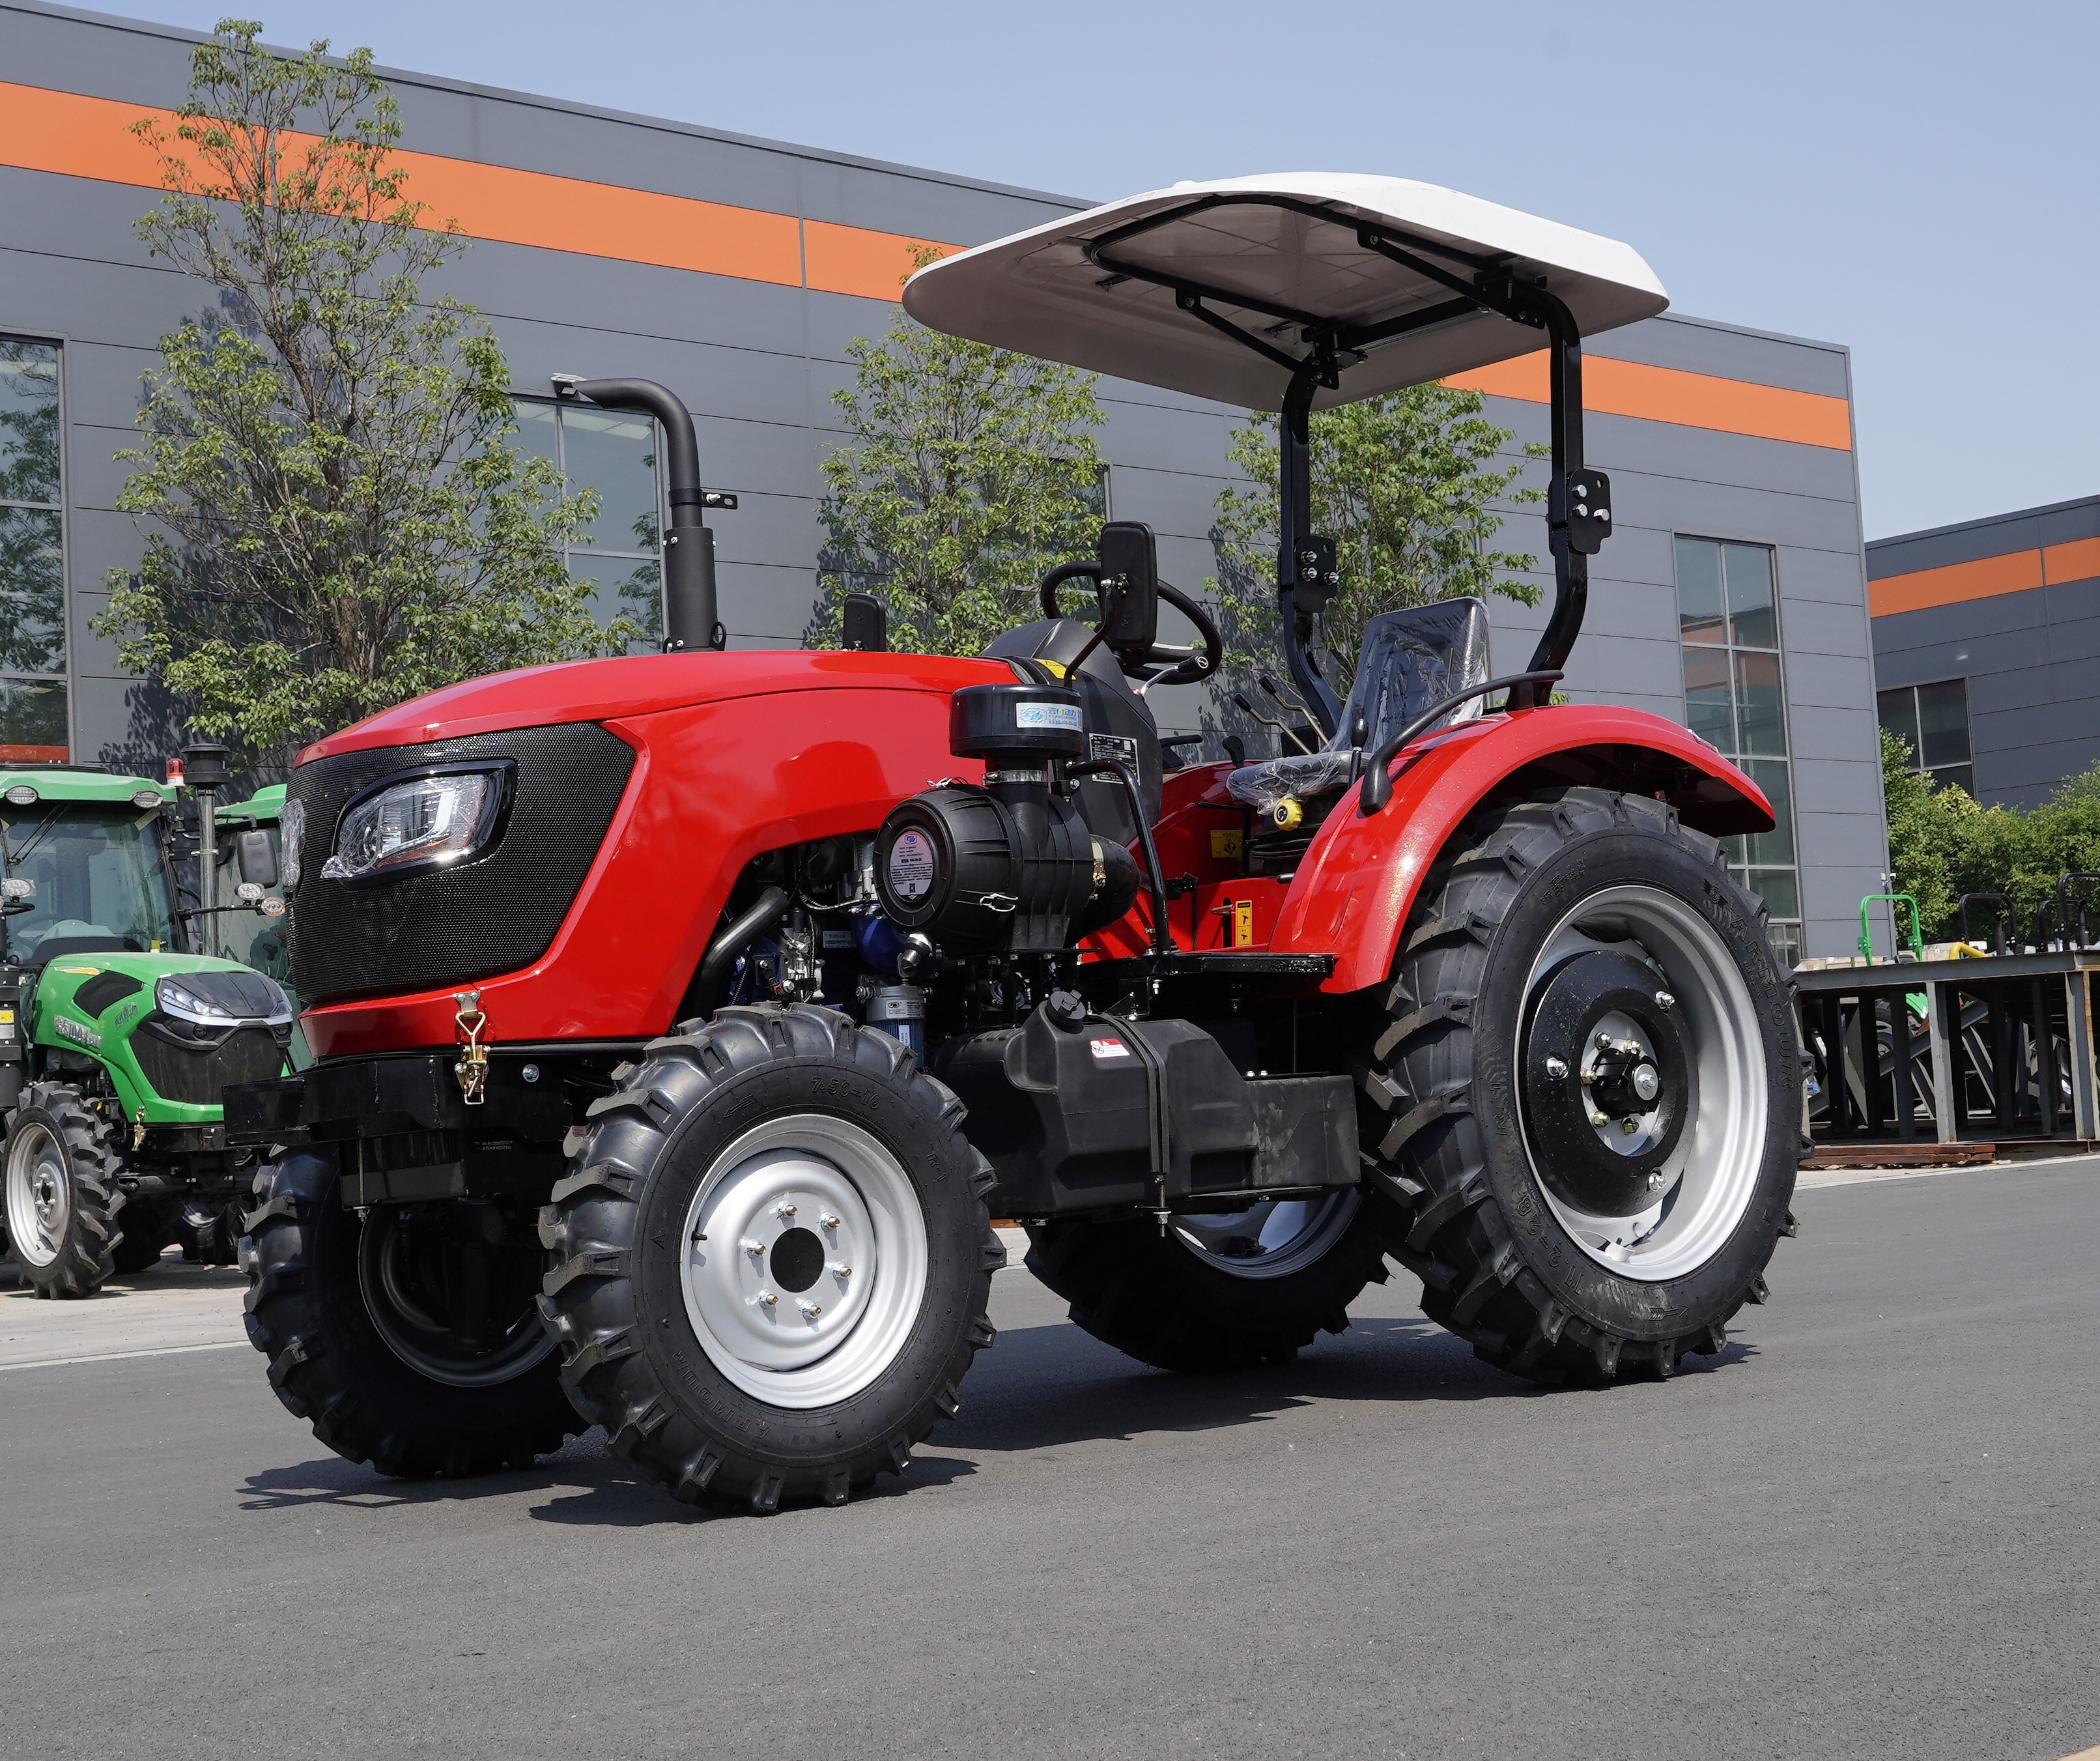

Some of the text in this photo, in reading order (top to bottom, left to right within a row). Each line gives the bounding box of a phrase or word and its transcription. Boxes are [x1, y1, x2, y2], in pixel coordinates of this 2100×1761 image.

[1731, 919, 1794, 1092] ARMOUR
[811, 1076, 881, 1110] 7.50-16
[926, 1152, 947, 1182] R-1
[1517, 1196, 1585, 1296] 11.2-28
[672, 1351, 771, 1439] ARMOUR
